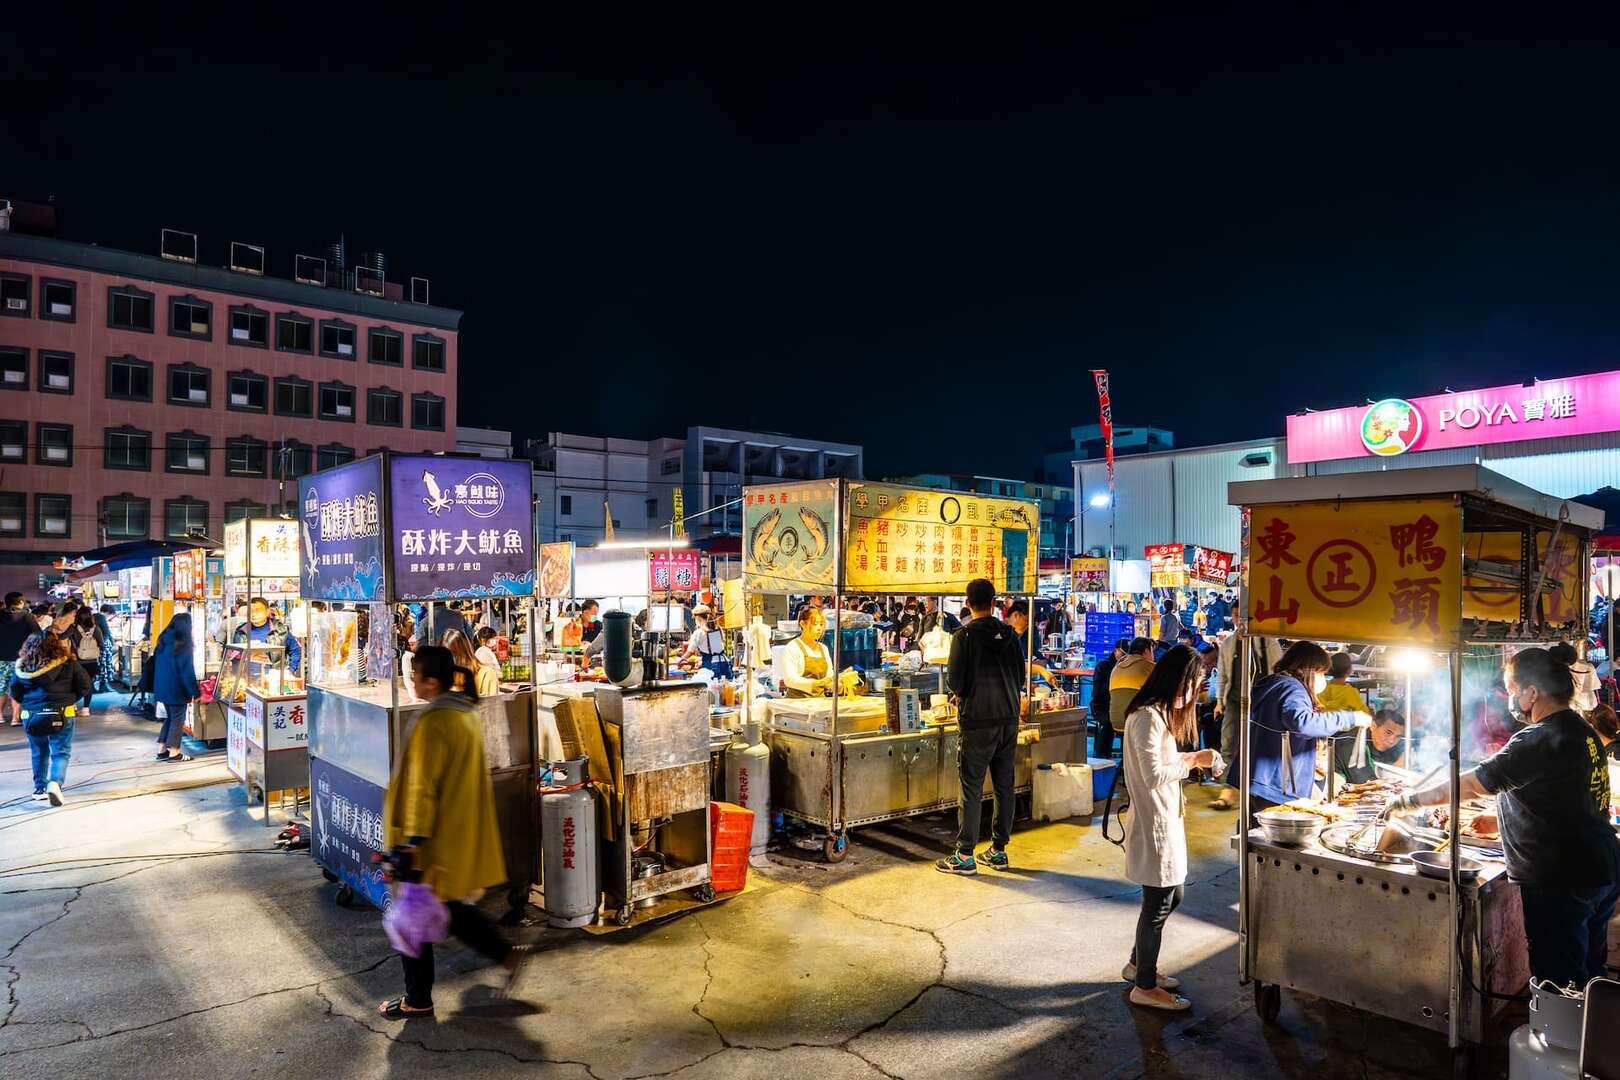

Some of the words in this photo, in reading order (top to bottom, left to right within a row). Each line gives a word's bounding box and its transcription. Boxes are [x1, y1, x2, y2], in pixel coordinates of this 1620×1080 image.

[1439, 401, 1519, 432] POYA
[1521, 394, 1577, 422] 寶雅
[321, 491, 379, 542] 酥炸大魷魚
[401, 528, 524, 556] 酥炸大魷魚
[855, 519, 869, 572] 魚丸湯
[913, 522, 927, 574] 炒米粉
[1254, 517, 1303, 625] 東山
[1321, 551, 1361, 593] 正
[1388, 513, 1447, 634] 鴨頭
